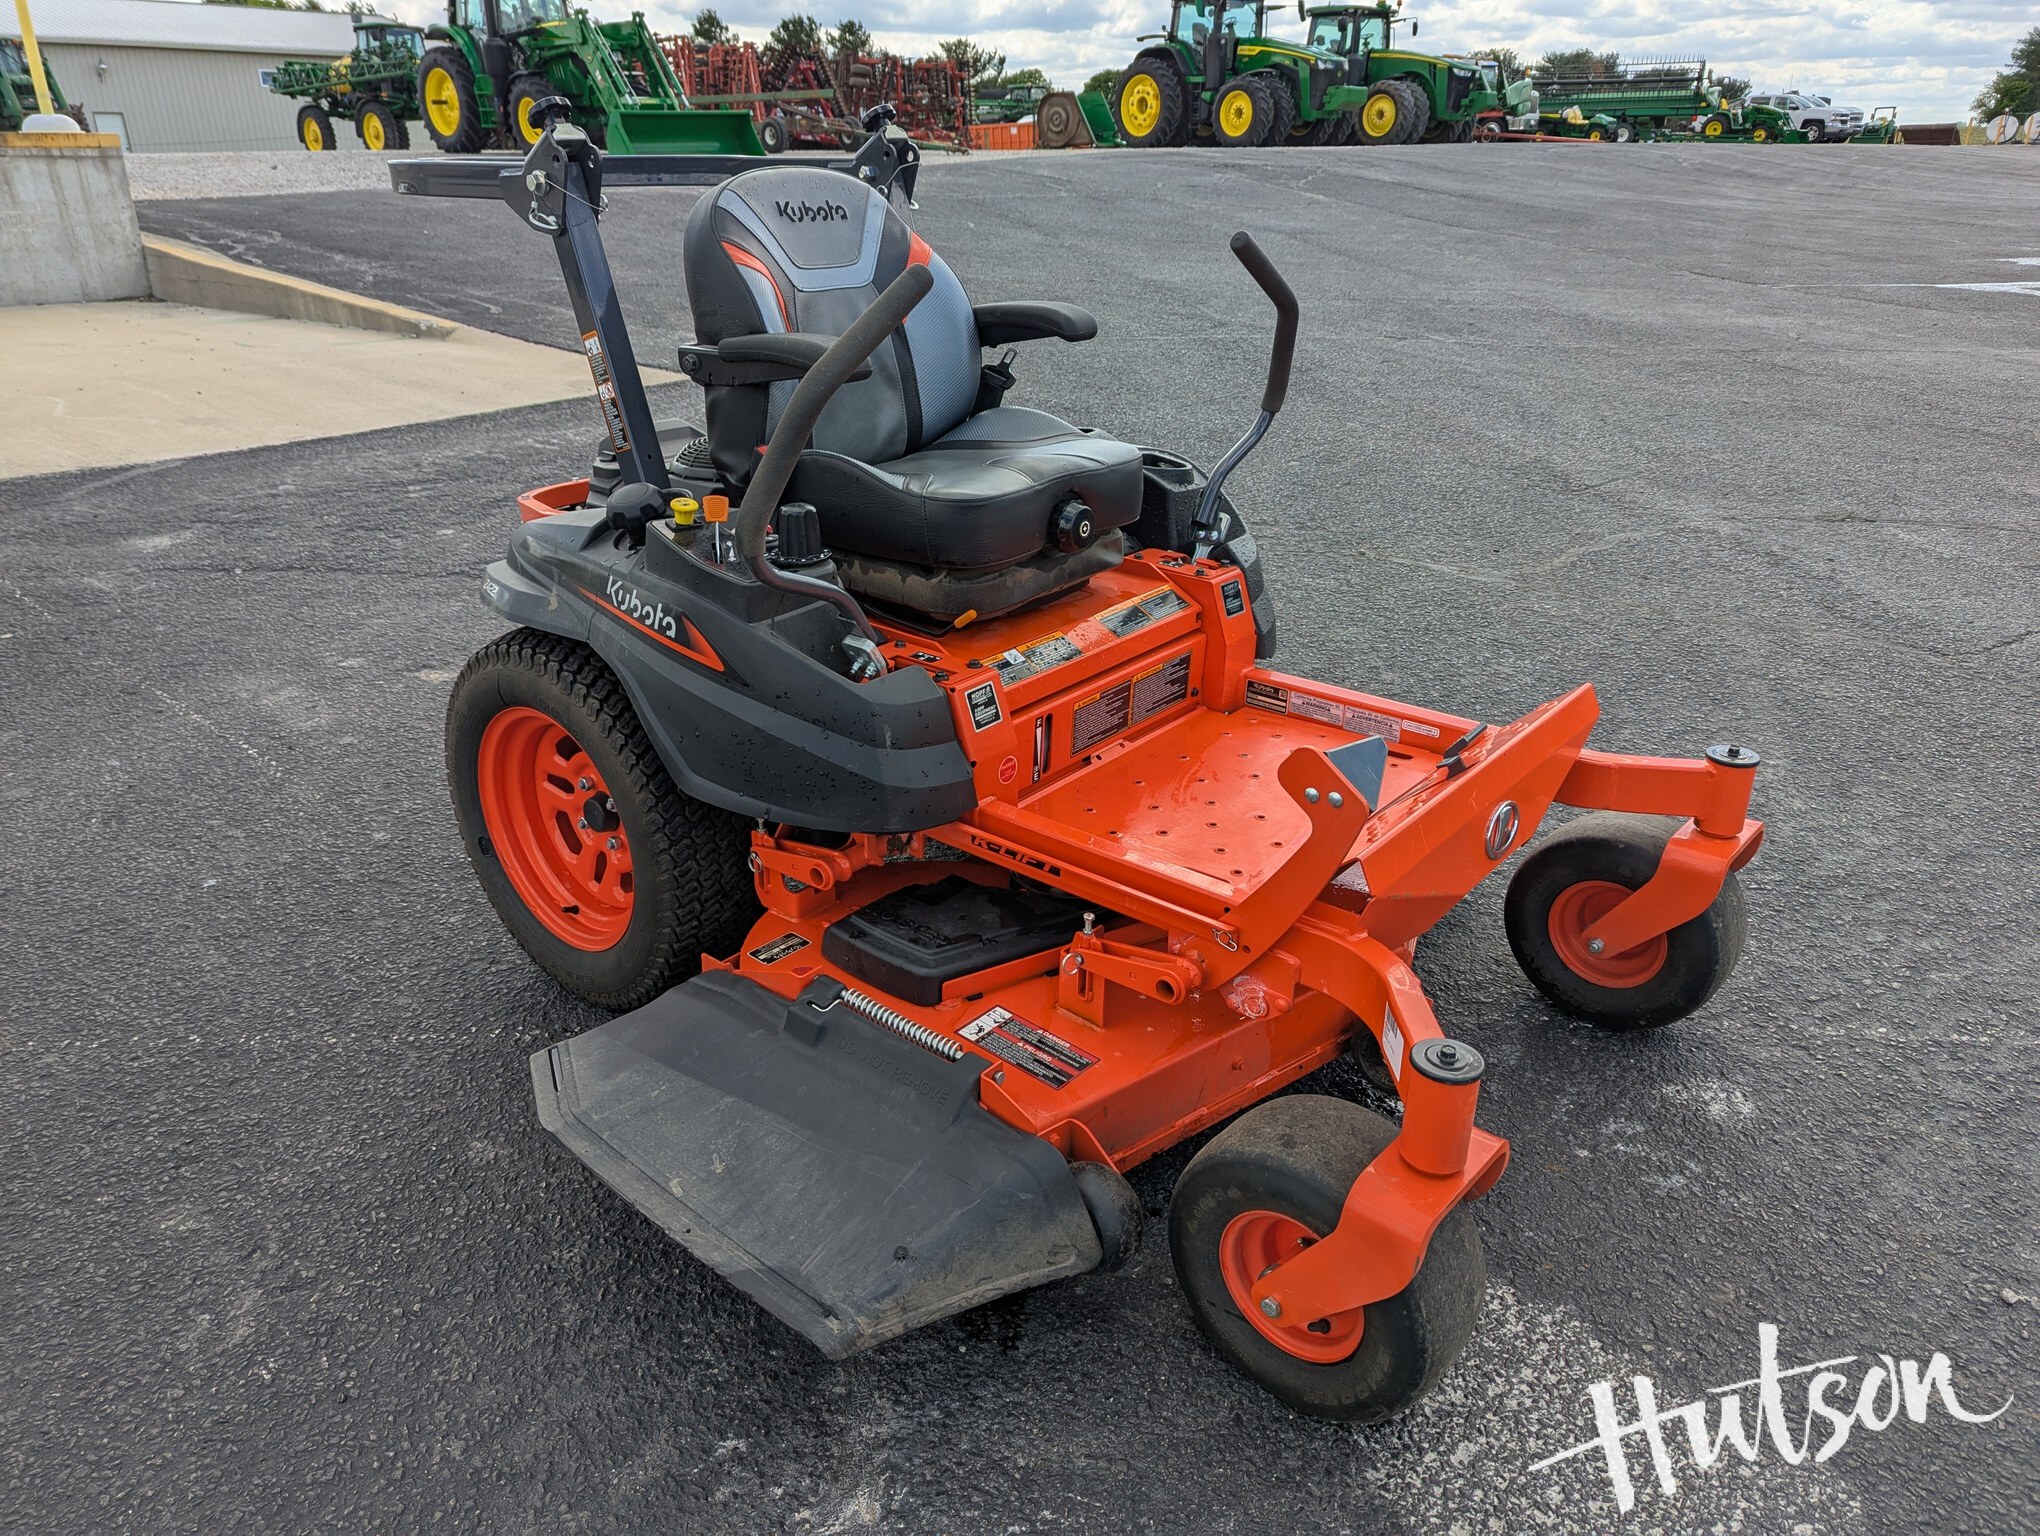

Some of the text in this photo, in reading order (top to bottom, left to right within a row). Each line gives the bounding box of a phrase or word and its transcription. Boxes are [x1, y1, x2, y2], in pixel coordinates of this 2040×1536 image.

[775, 200, 848, 223] Kubota
[606, 575, 677, 639] Kubota
[1043, 1029, 1071, 1048] DANGER
[1024, 1044, 1053, 1062] PELIGRO
[891, 1067, 949, 1106] REMOVE
